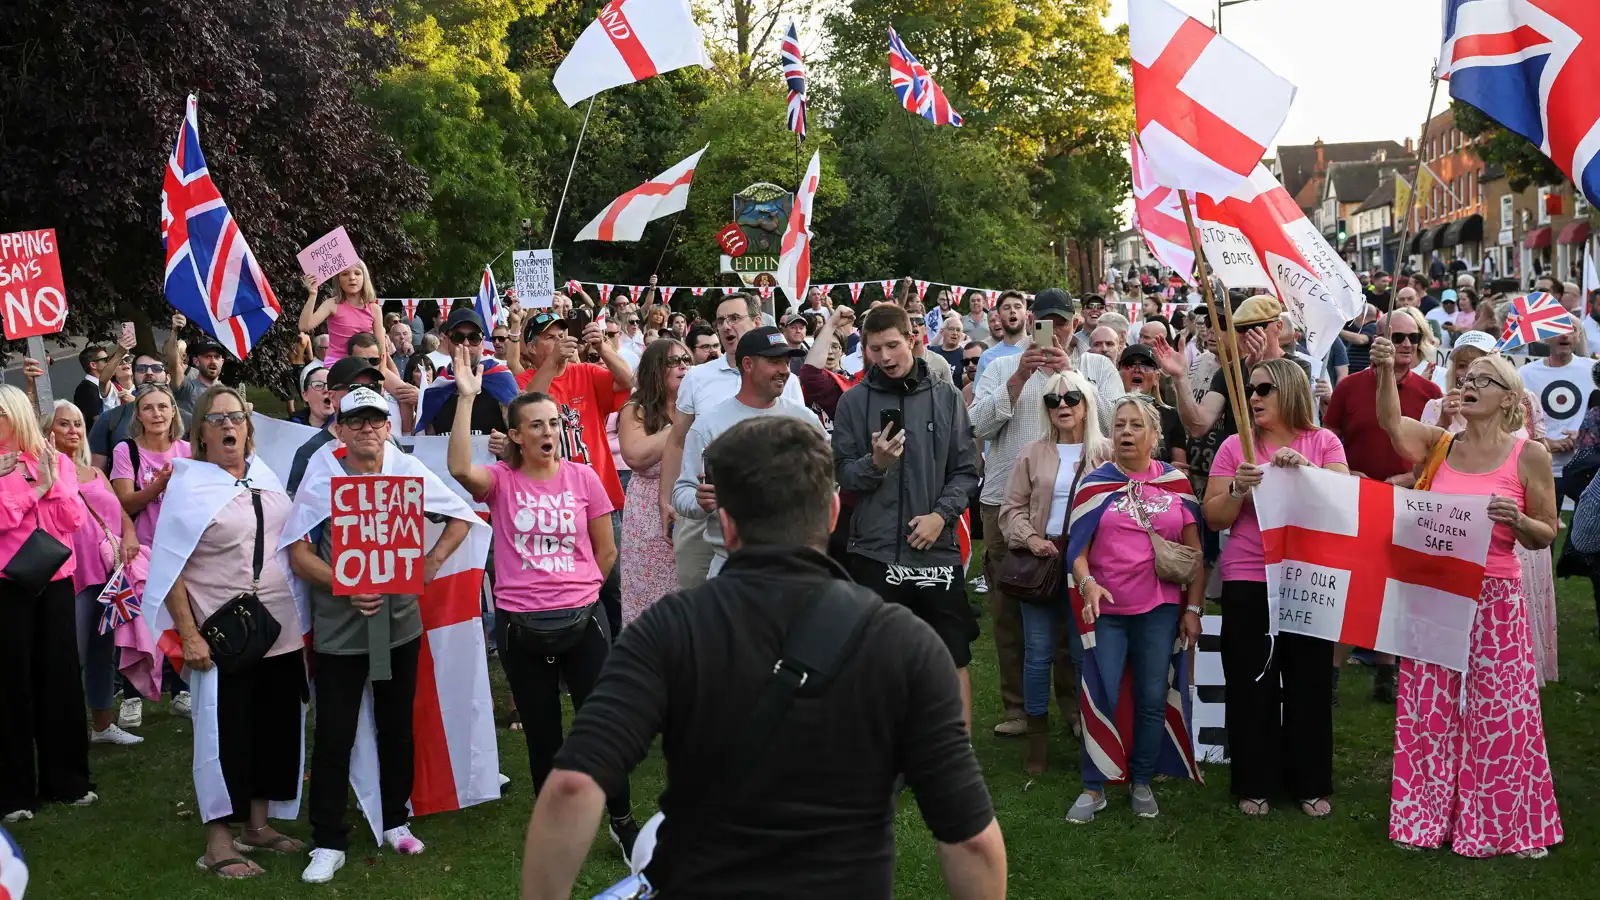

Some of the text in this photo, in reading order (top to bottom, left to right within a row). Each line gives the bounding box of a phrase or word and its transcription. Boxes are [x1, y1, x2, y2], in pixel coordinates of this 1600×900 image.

[1202, 227, 1226, 243] STOP
[0, 231, 53, 260] PPING
[310, 236, 339, 260] PROTECT
[528, 250, 536, 259] A
[318, 252, 345, 273] AND OUR
[321, 251, 332, 262] US
[513, 258, 553, 268] GOVERNMENT
[735, 254, 780, 271] EPPIN
[1222, 251, 1254, 266] BOATS
[0, 258, 42, 286] SAYS
[322, 259, 347, 278] FUTURE
[514, 266, 548, 275] FAILING TO
[515, 273, 550, 283] PROTECT US
[537, 281, 549, 289] ACT
[1277, 264, 1332, 302] PROTEC
[517, 289, 552, 298] OF TREASON
[5, 286, 65, 334] NO
[334, 479, 423, 517] CLEAR
[515, 490, 576, 509] LEAVE
[514, 507, 577, 534] OUR
[1406, 499, 1472, 522] KEEP OUR
[334, 512, 421, 546] THEM
[514, 533, 576, 557] KIDS
[1425, 535, 1454, 552] SAFE
[335, 549, 421, 586] OUT
[1280, 566, 1337, 591] EP OUR
[1279, 587, 1336, 608] HILDREN
[1279, 607, 1313, 625] SAFE
